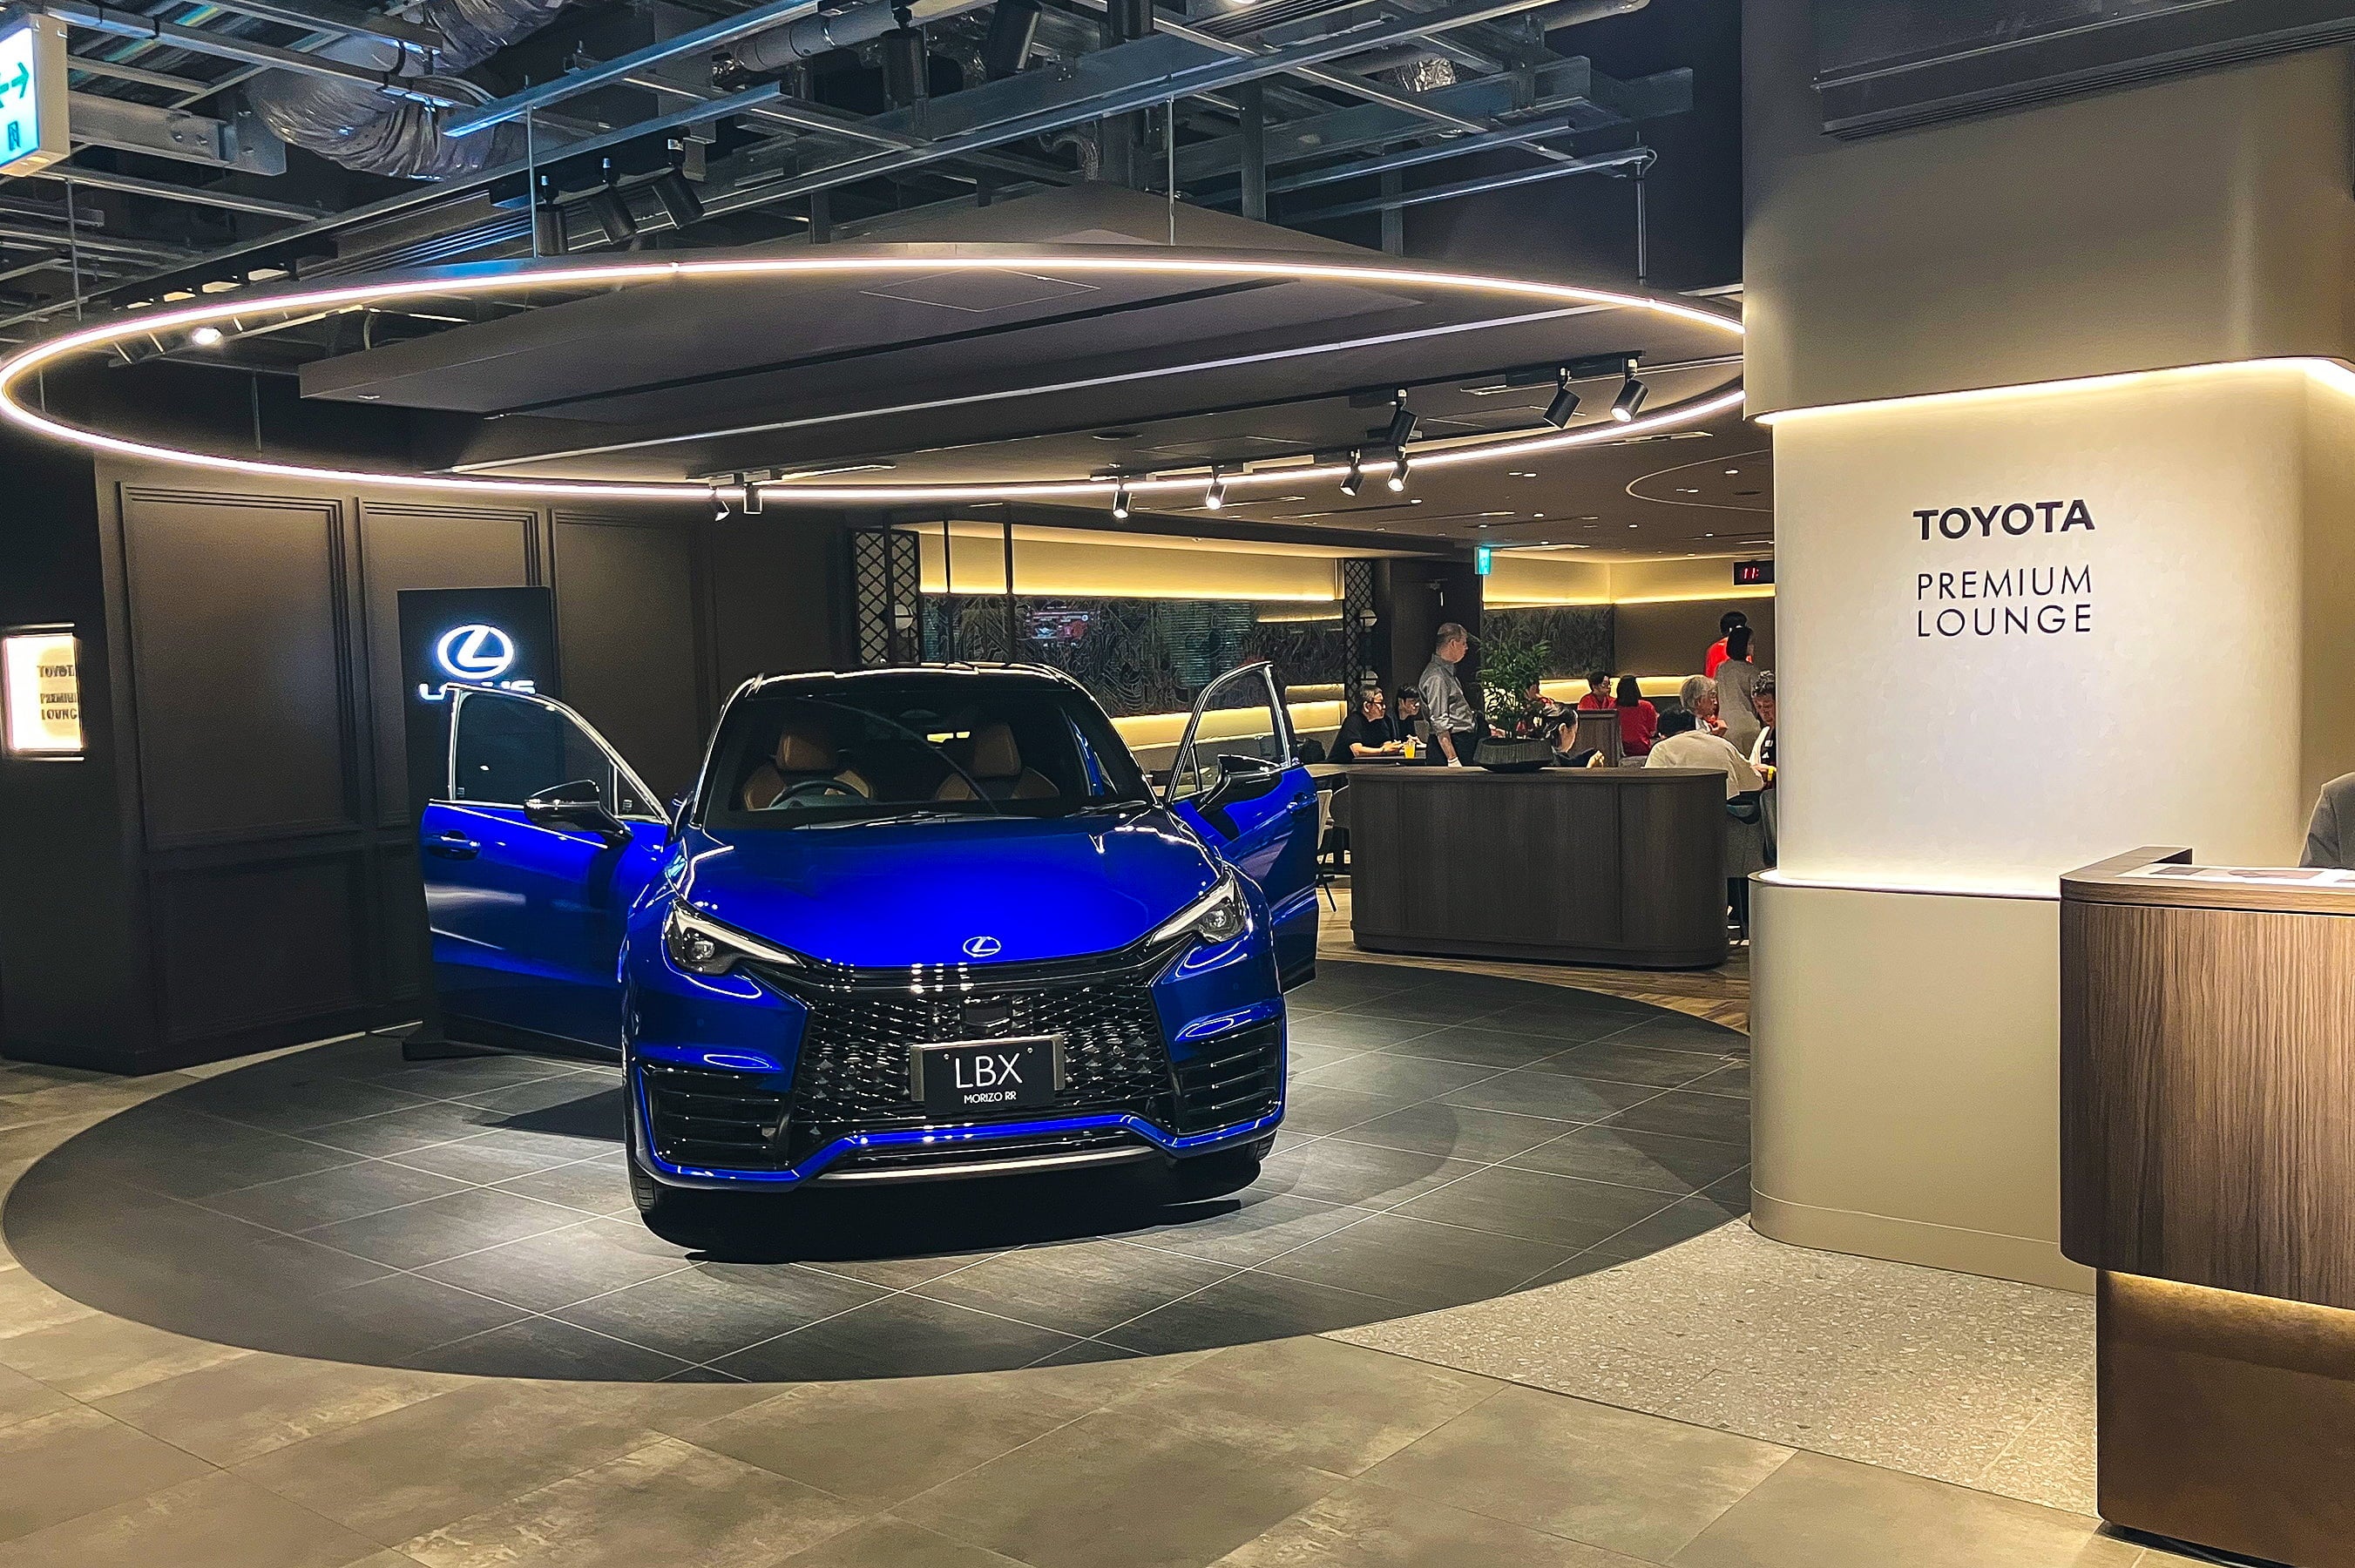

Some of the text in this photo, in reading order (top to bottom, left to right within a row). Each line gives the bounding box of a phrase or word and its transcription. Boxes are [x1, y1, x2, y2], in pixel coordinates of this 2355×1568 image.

[1912, 499, 2095, 541] TOYOTA
[1917, 564, 2092, 601] PREMIUM
[1917, 604, 2091, 638] LOUNGE
[37, 665, 75, 678] TOYOT
[41, 707, 78, 720] LOUNG
[955, 1052, 1023, 1089] LBX
[964, 1091, 1017, 1105] MORIZO RR
